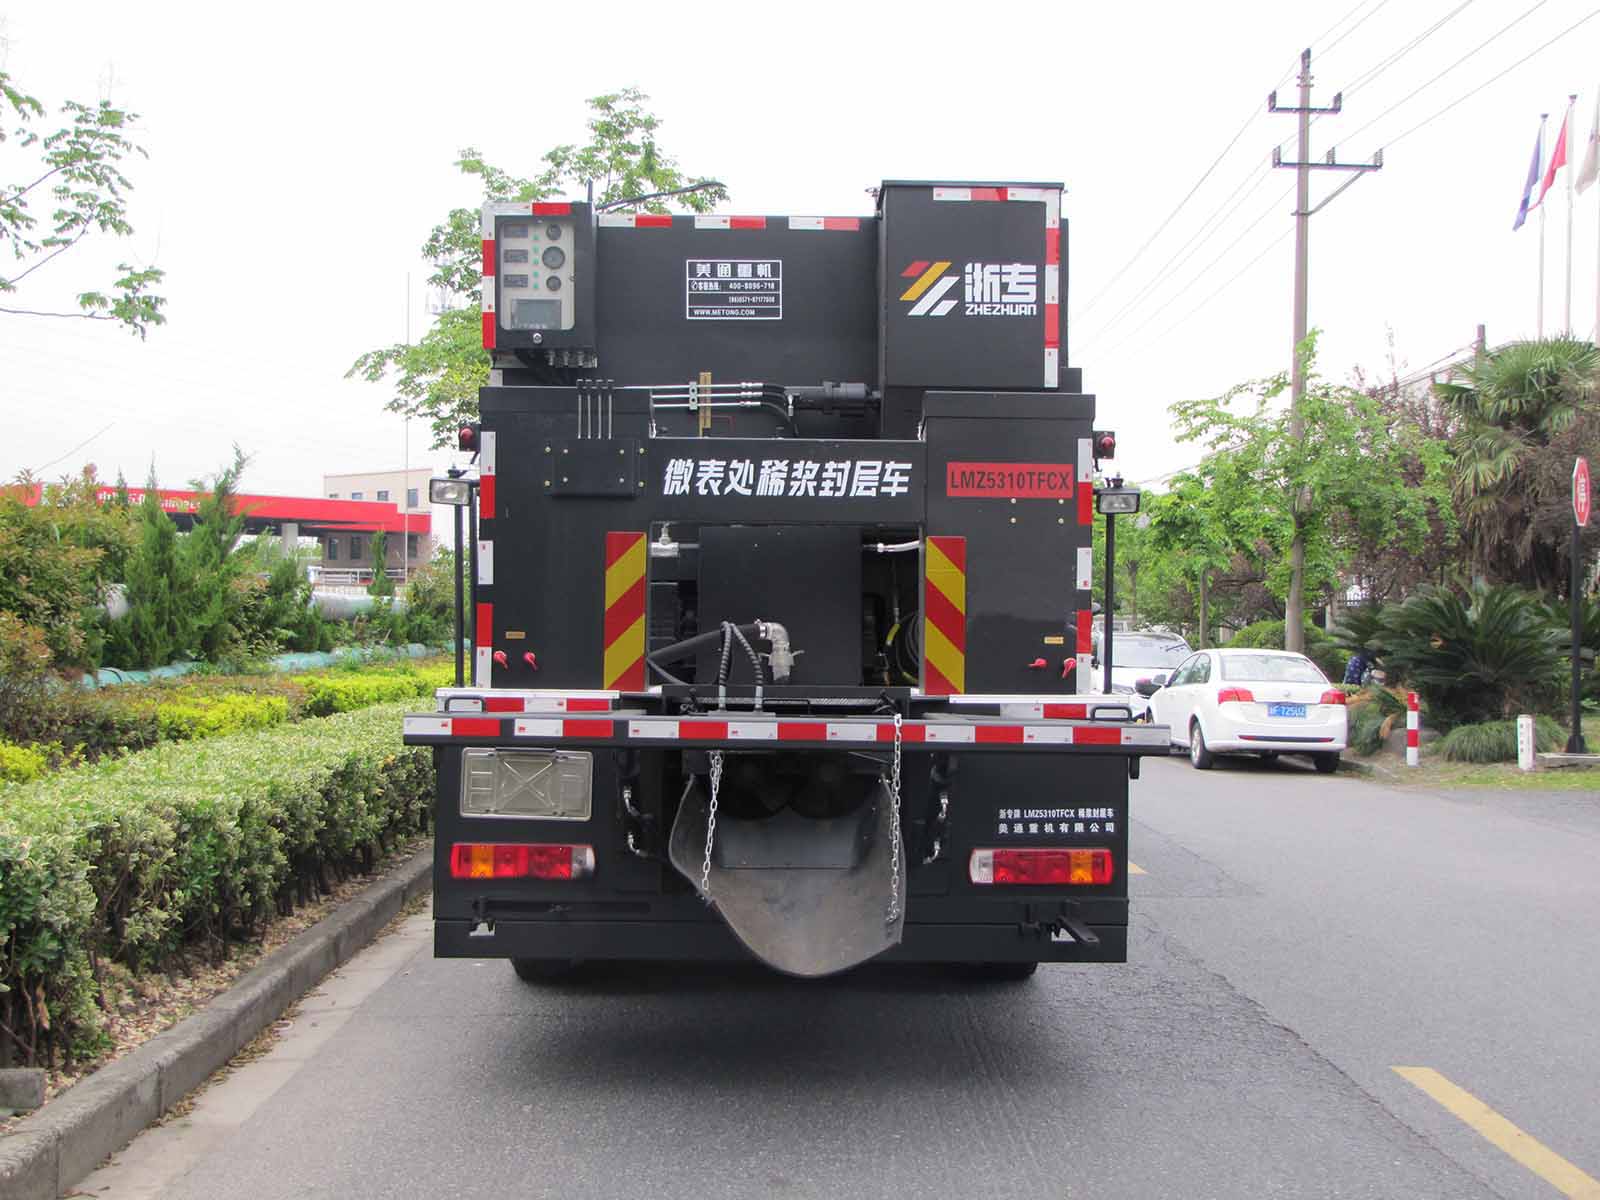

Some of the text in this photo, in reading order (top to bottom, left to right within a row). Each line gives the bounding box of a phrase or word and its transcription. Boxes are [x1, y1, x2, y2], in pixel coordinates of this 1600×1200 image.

[693, 308, 756, 317] WWW.METONG.COM
[964, 303, 1037, 316] ZHEZHUAN
[663, 458, 913, 497] 微表处稀浆封层车
[950, 470, 1070, 490] LMZ5310TFCX
[1023, 808, 1075, 818] LMZ5310TFCX
[998, 822, 1115, 834] 美通重机有限公司
